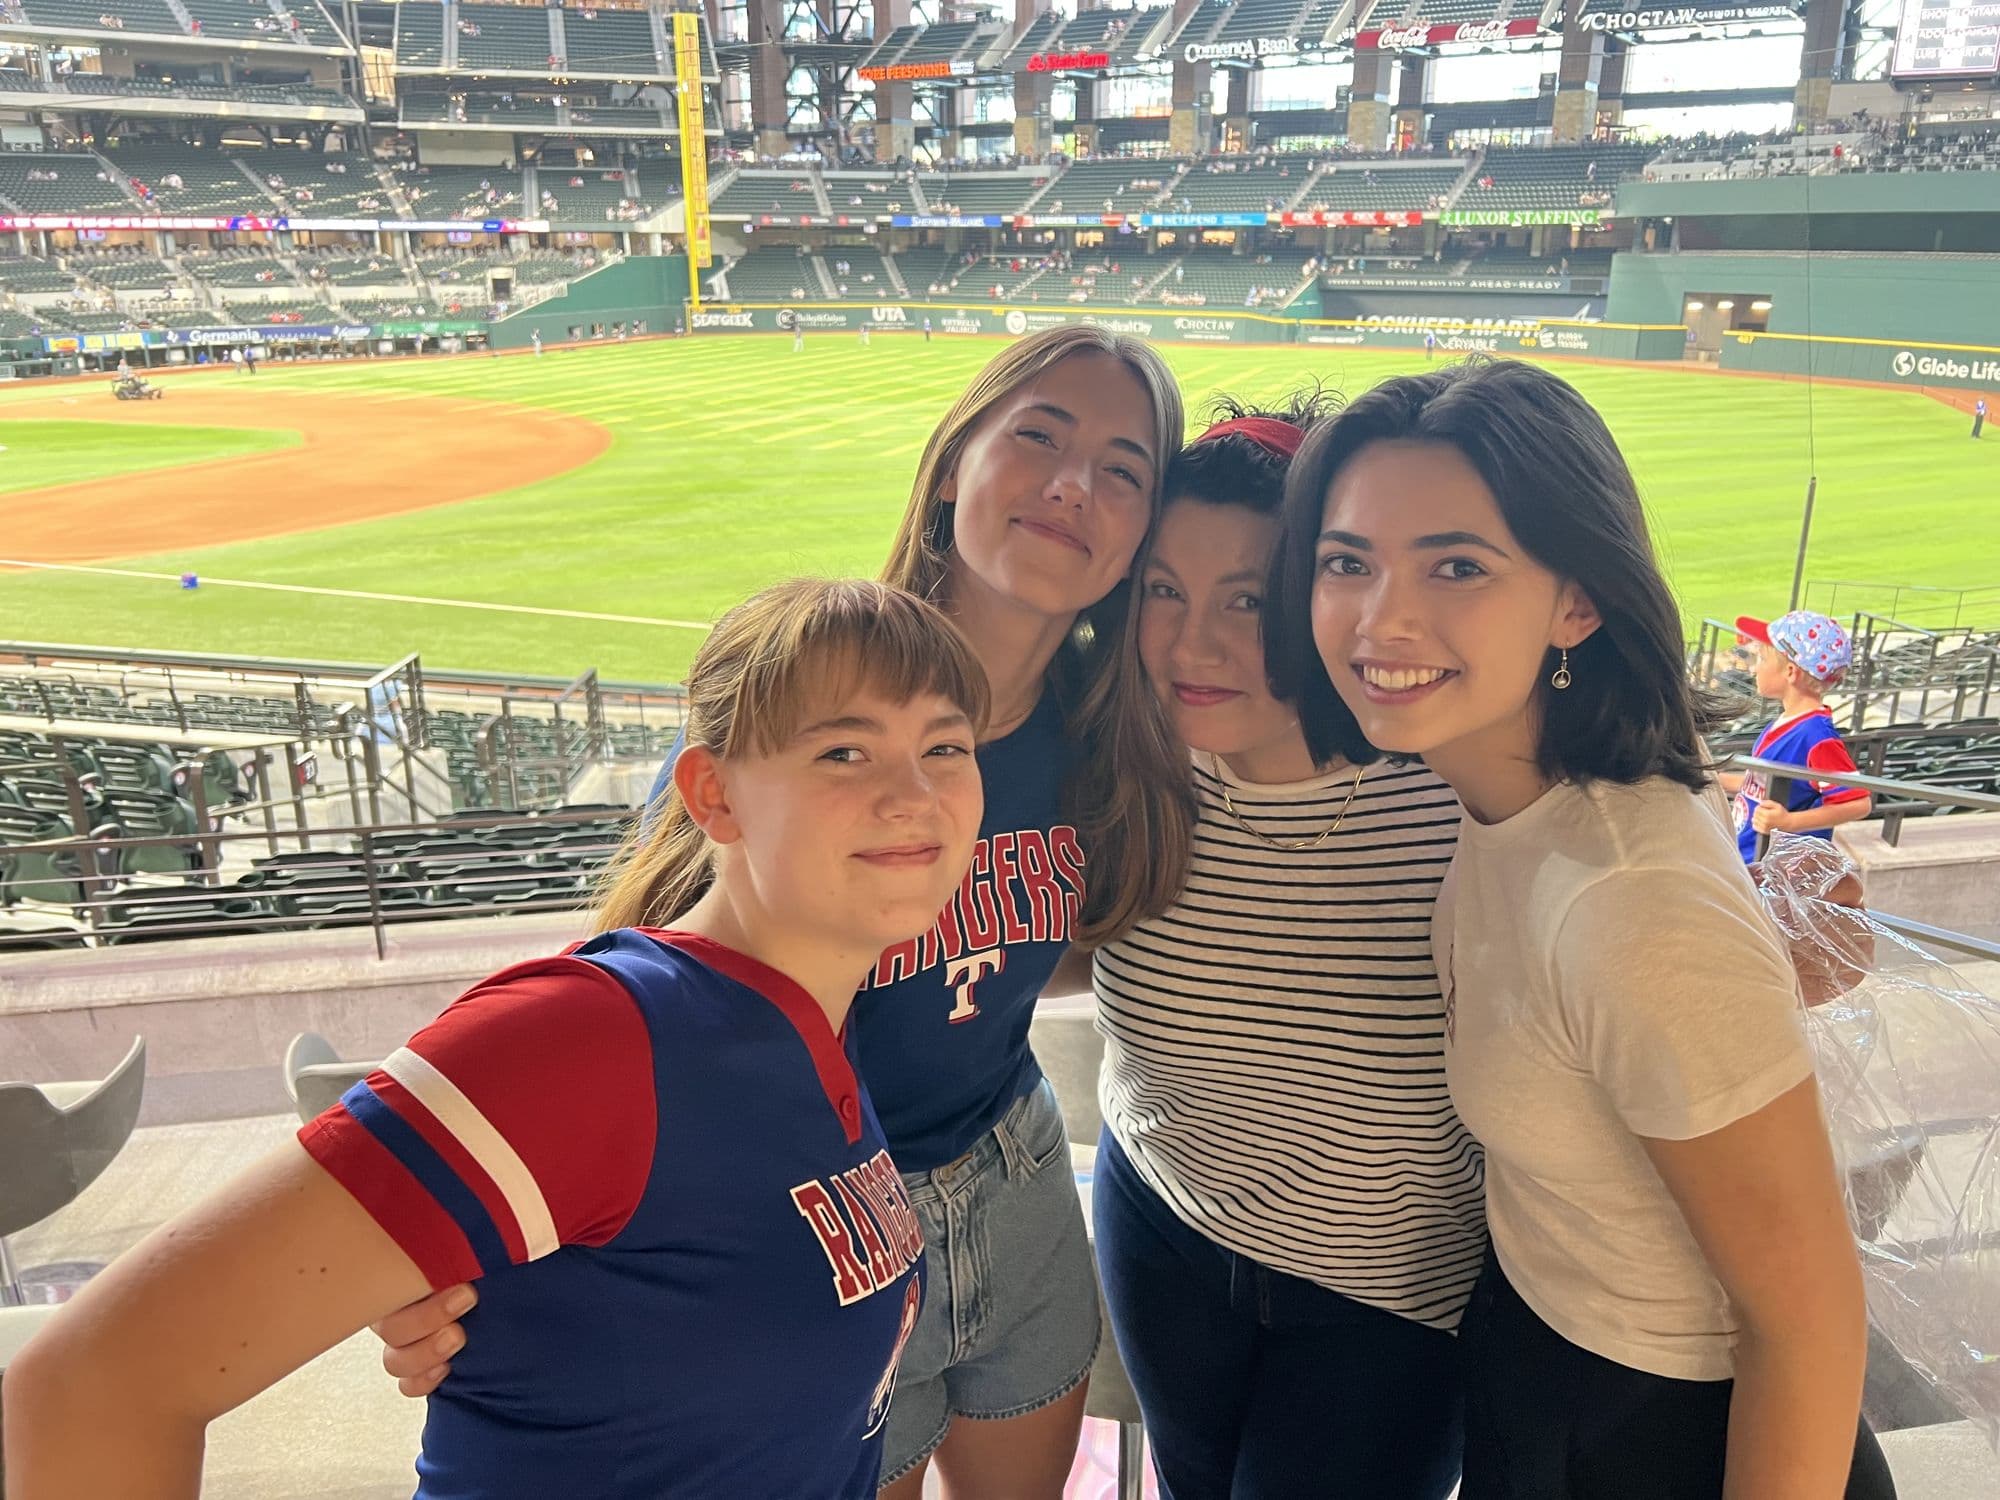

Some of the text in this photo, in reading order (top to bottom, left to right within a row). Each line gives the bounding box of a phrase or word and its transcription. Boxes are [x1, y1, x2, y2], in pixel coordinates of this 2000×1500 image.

[1591, 8, 1696, 30] CHOCTAW
[1257, 36, 1299, 54] Bank
[886, 61, 950, 78] PERSONNEL
[1455, 210, 1596, 226] LUXOR STAFFING
[872, 307, 907, 322] UTA
[1181, 318, 1235, 331] CHOCTAW
[189, 328, 260, 343] Germania
[1918, 357, 1969, 378] Globe
[945, 949, 1006, 1024] T
